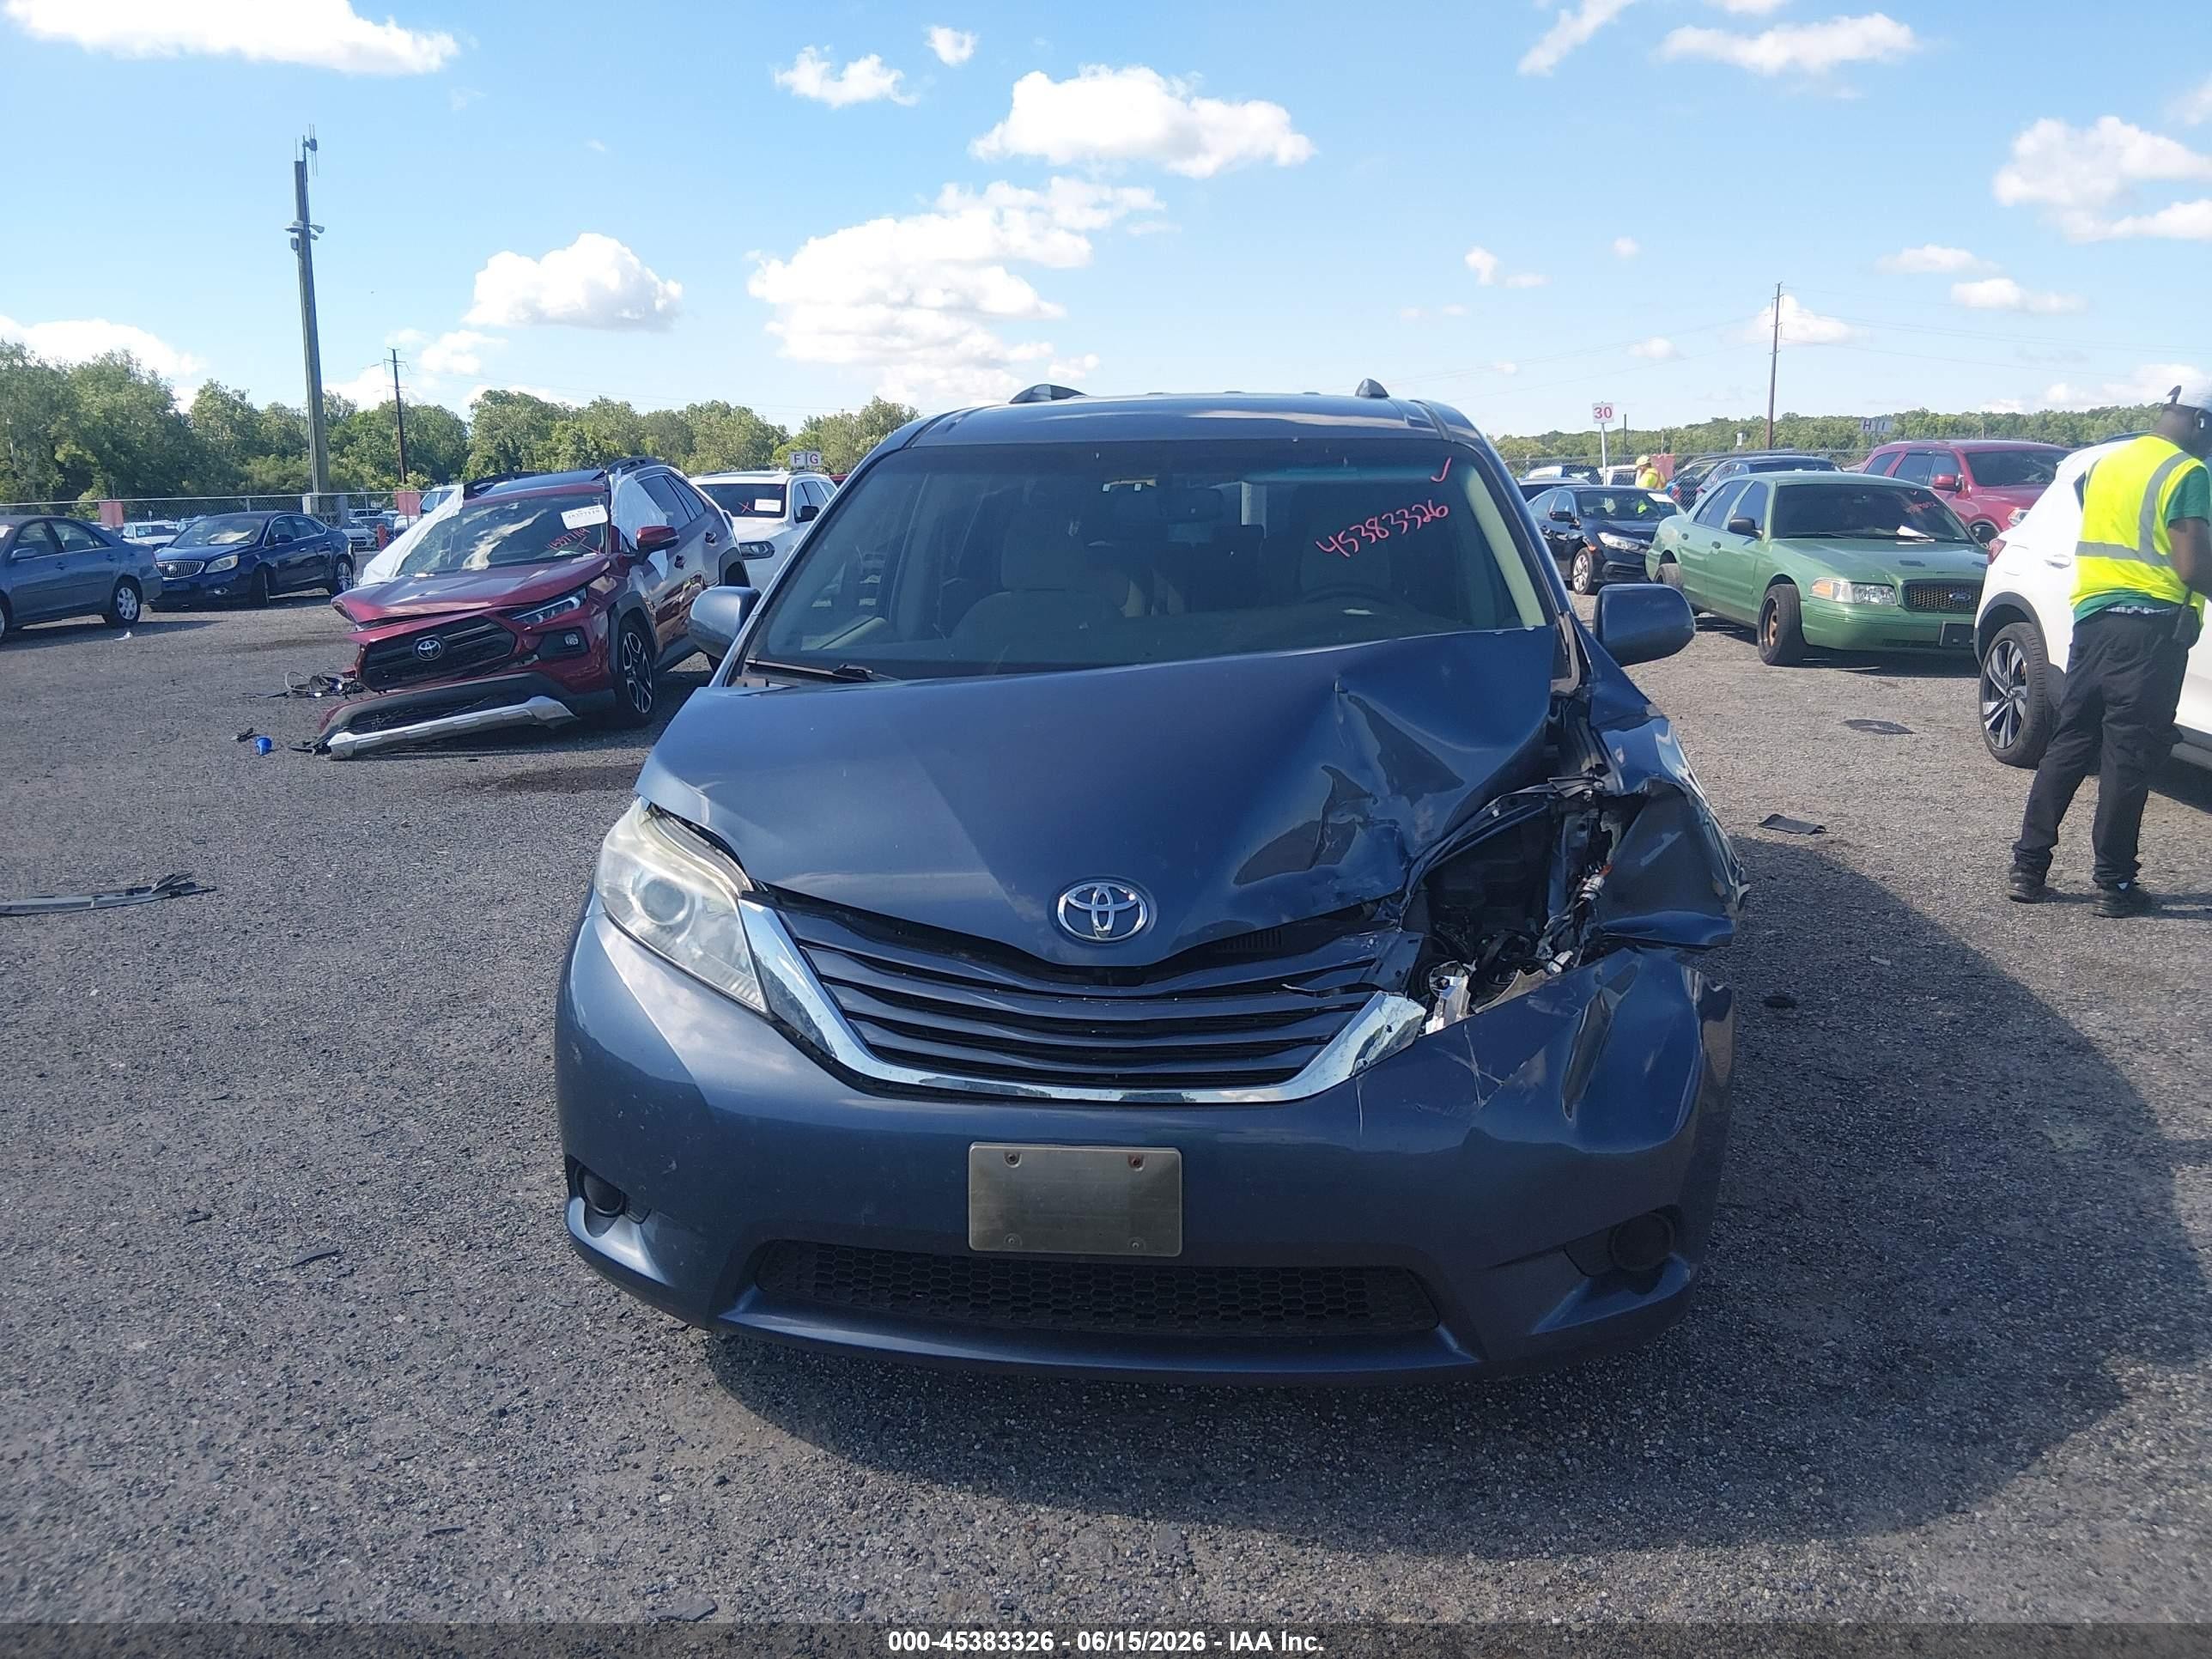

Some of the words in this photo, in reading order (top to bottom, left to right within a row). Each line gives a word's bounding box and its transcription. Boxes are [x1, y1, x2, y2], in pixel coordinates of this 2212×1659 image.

[1593, 406, 1613, 419] 30
[1863, 419, 1872, 430] H
[793, 454, 801, 464] F
[809, 453, 819, 465] G
[1316, 500, 1449, 557] 45383326
